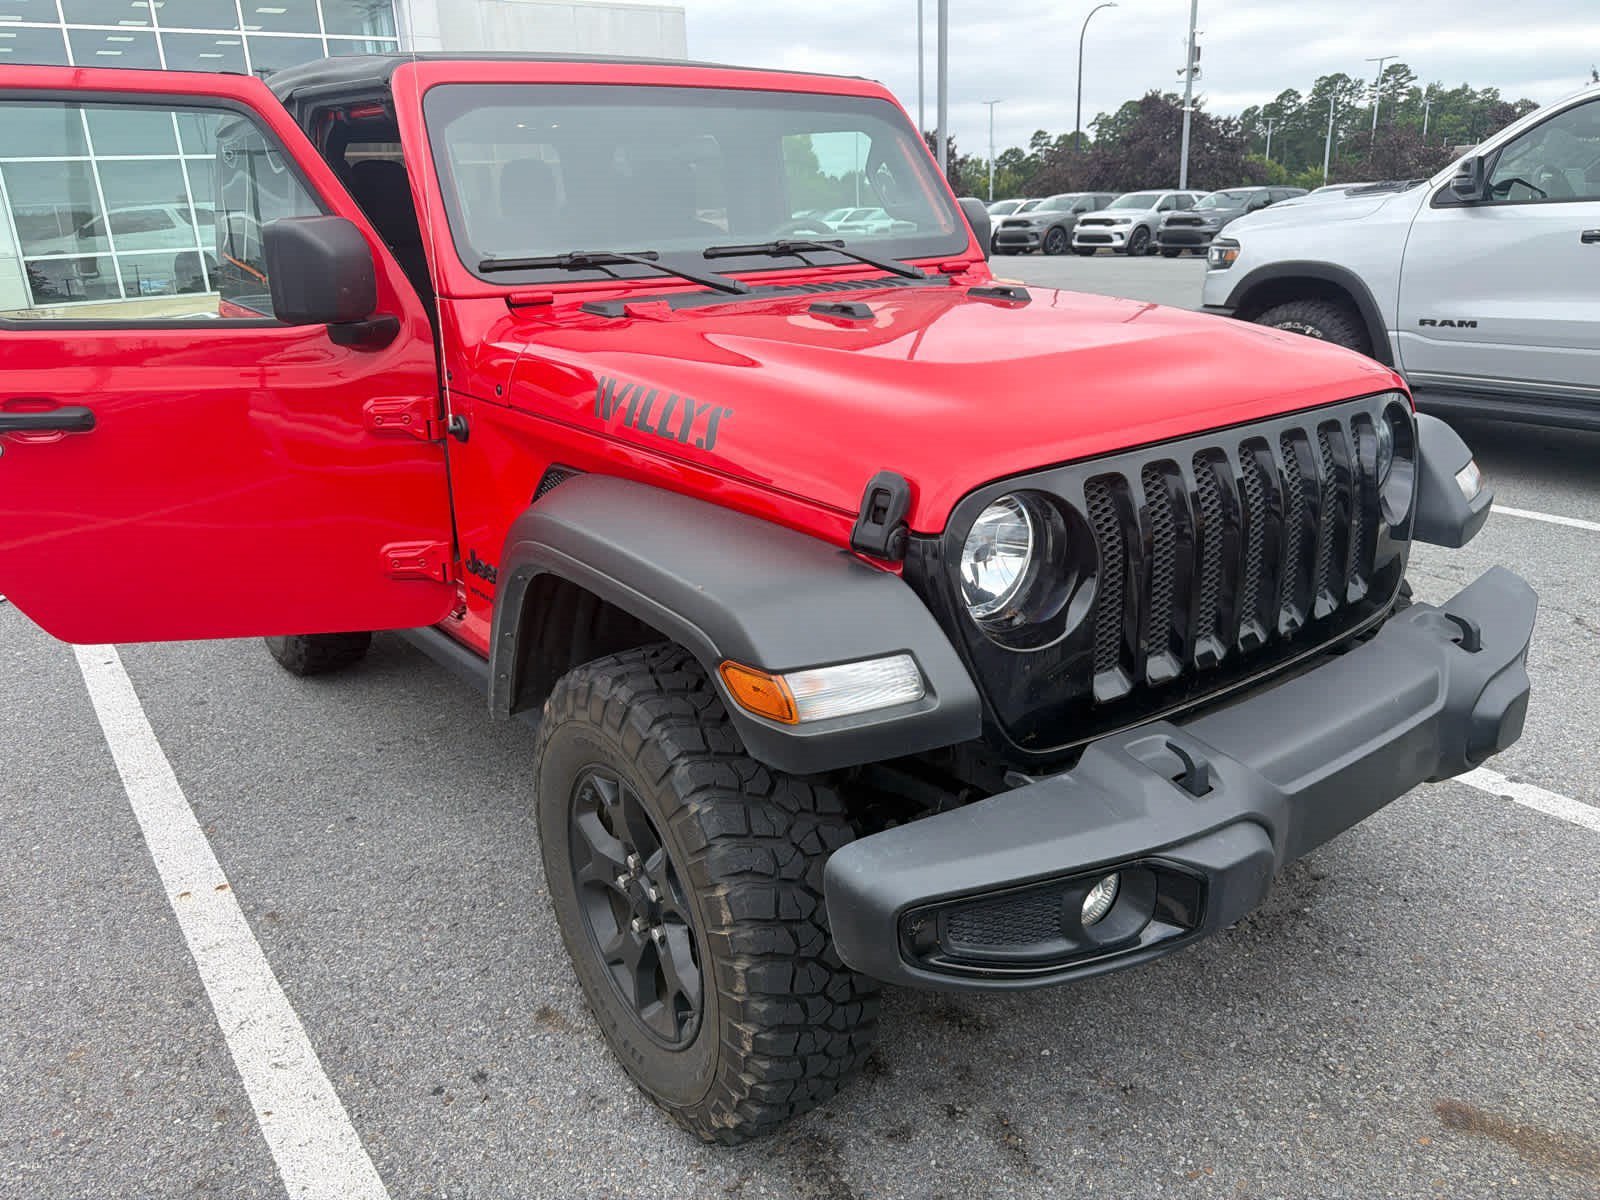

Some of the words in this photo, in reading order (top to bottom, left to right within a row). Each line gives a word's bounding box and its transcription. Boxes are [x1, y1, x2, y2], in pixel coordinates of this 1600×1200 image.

[1418, 318, 1478, 328] RAM
[593, 375, 734, 451] WILLYS
[465, 548, 498, 585] Jee
